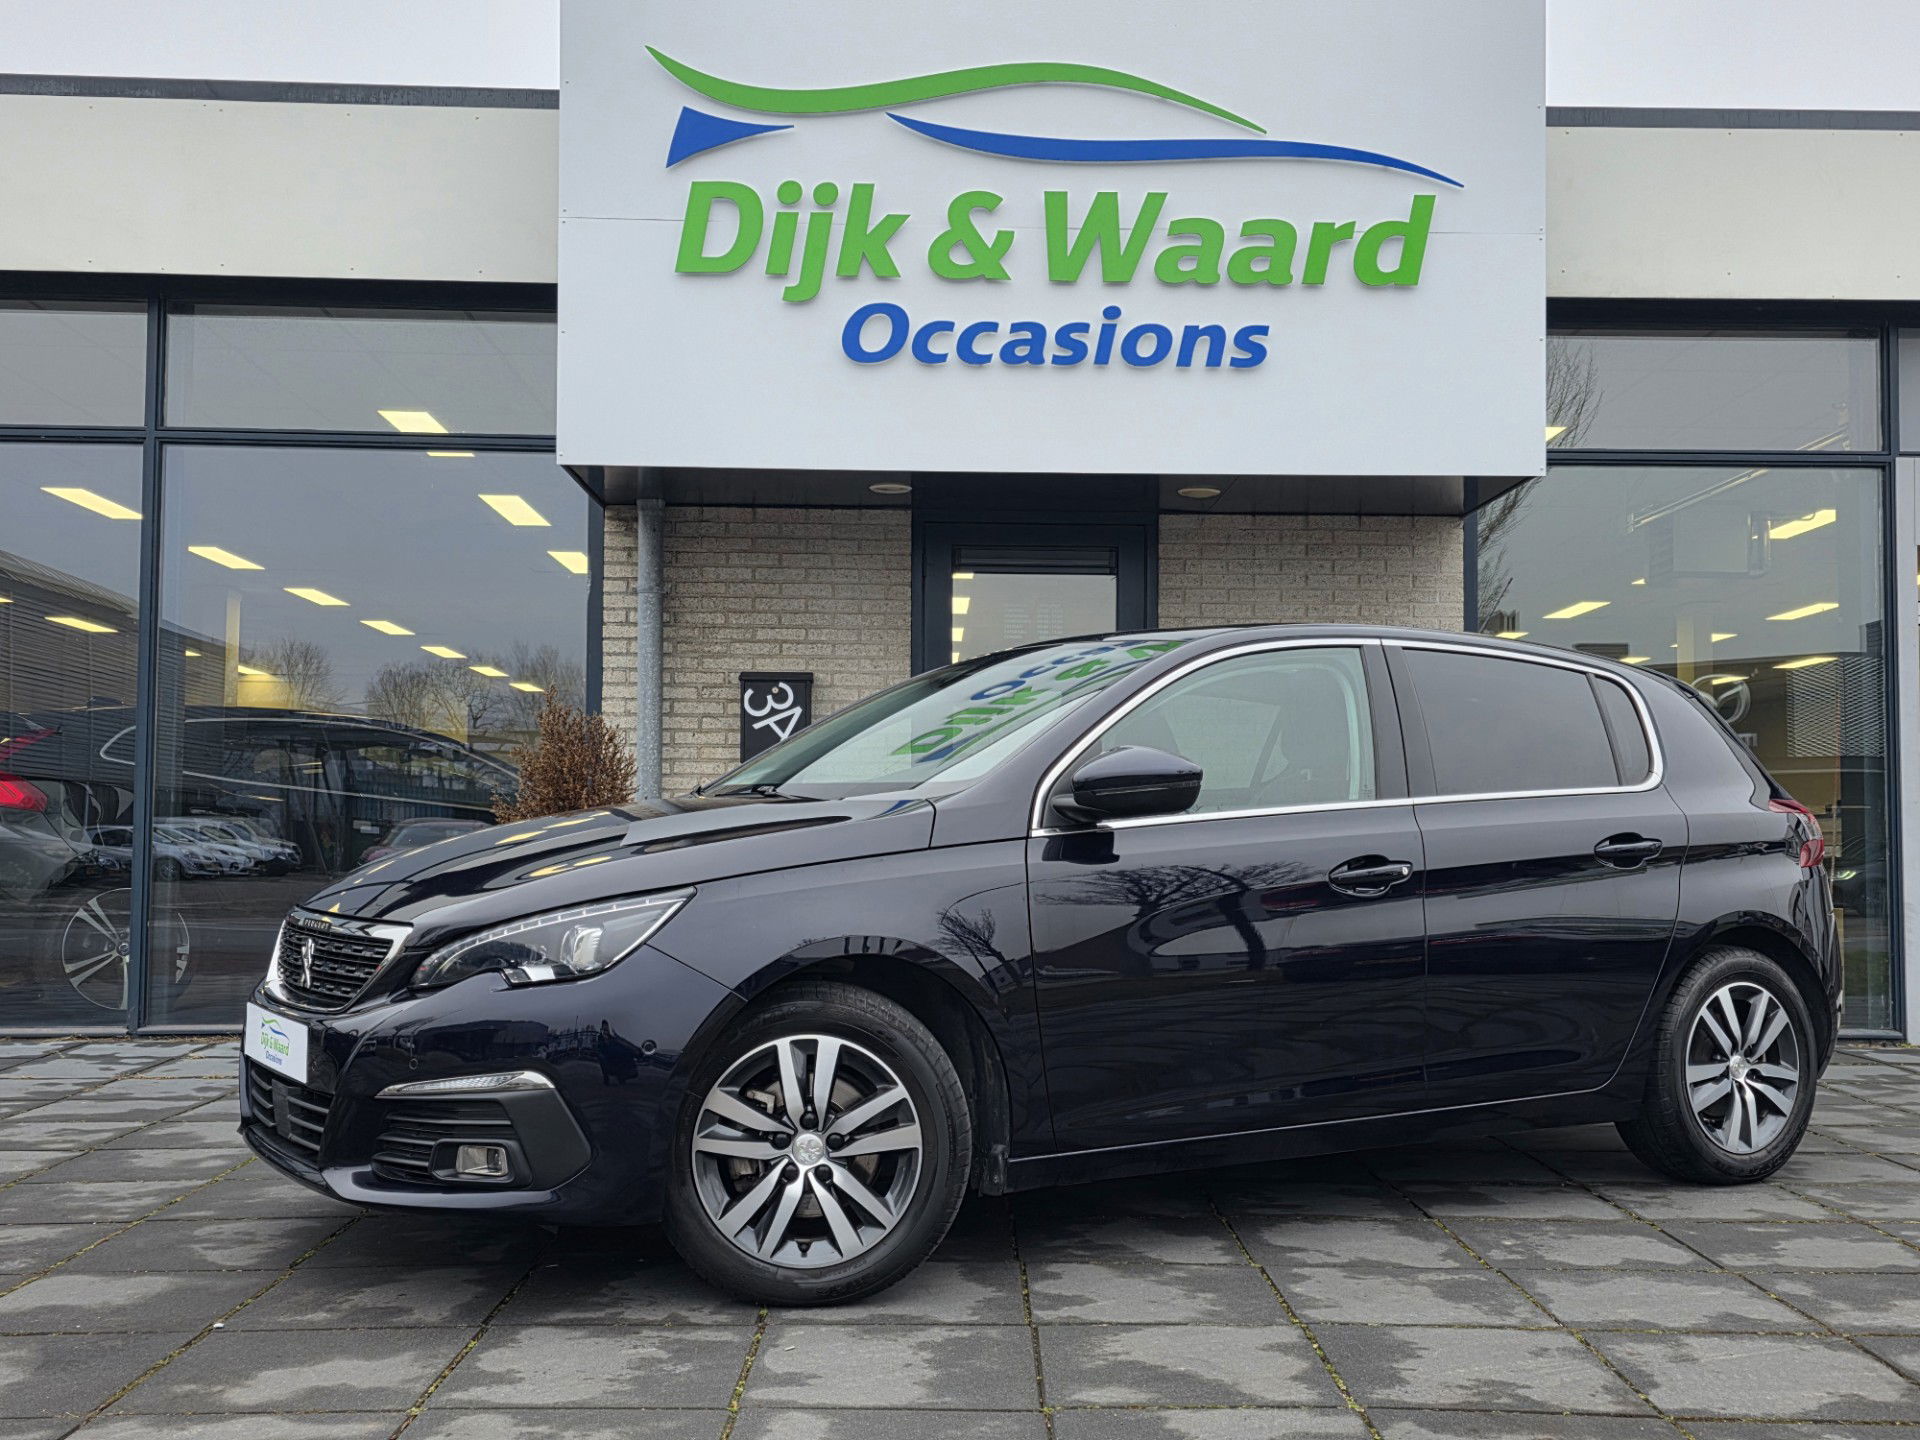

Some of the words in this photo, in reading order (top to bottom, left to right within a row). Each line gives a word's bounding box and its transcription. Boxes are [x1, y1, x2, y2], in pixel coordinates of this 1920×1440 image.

[675, 181, 909, 302] Dijk
[928, 191, 1014, 282] &
[1044, 191, 1436, 287] Waard
[841, 302, 1270, 369] Occasions
[743, 682, 803, 742] 3A
